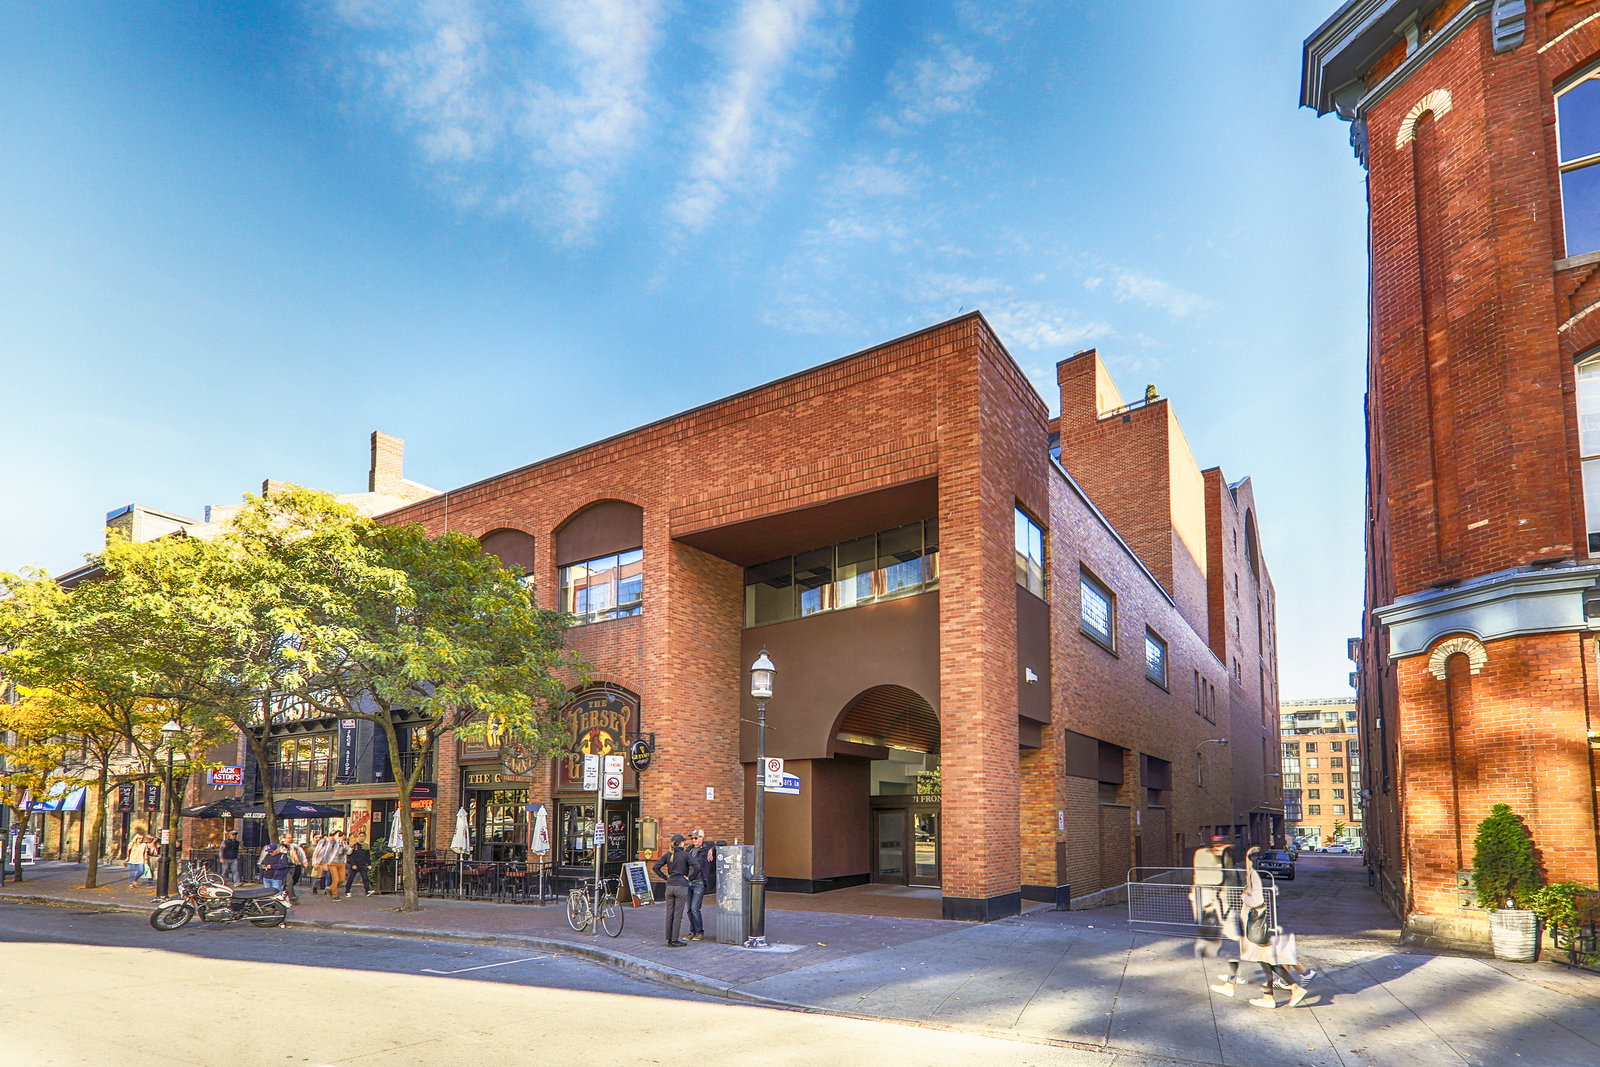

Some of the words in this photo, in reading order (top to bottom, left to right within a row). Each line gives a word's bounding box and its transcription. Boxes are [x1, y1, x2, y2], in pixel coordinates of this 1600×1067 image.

[588, 700, 608, 708] THE
[568, 705, 631, 747] JERSEY
[213, 773, 241, 781] ASTOR'S
[468, 774, 491, 784] THE
